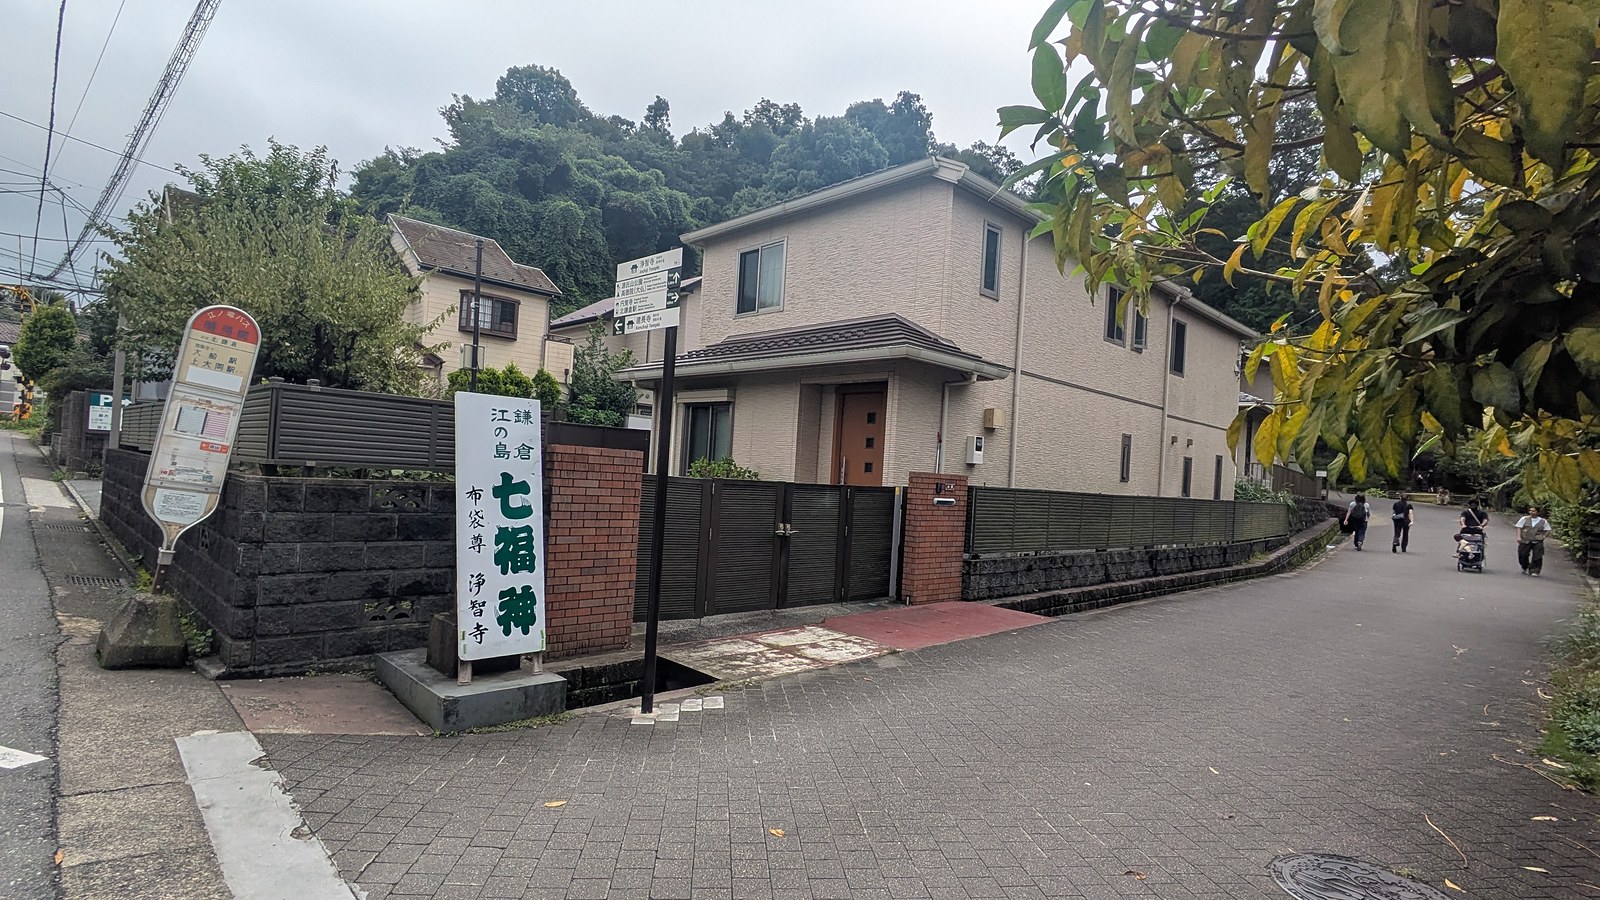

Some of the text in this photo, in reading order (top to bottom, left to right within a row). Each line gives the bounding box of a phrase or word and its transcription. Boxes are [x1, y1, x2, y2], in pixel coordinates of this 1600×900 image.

[99, 394, 113, 406] P
[490, 407, 512, 460] 江の島
[513, 408, 535, 460] 鎌倉
[465, 485, 487, 554] 布袋尊
[491, 471, 538, 637] 七福神
[468, 572, 489, 645] 浄智寺
